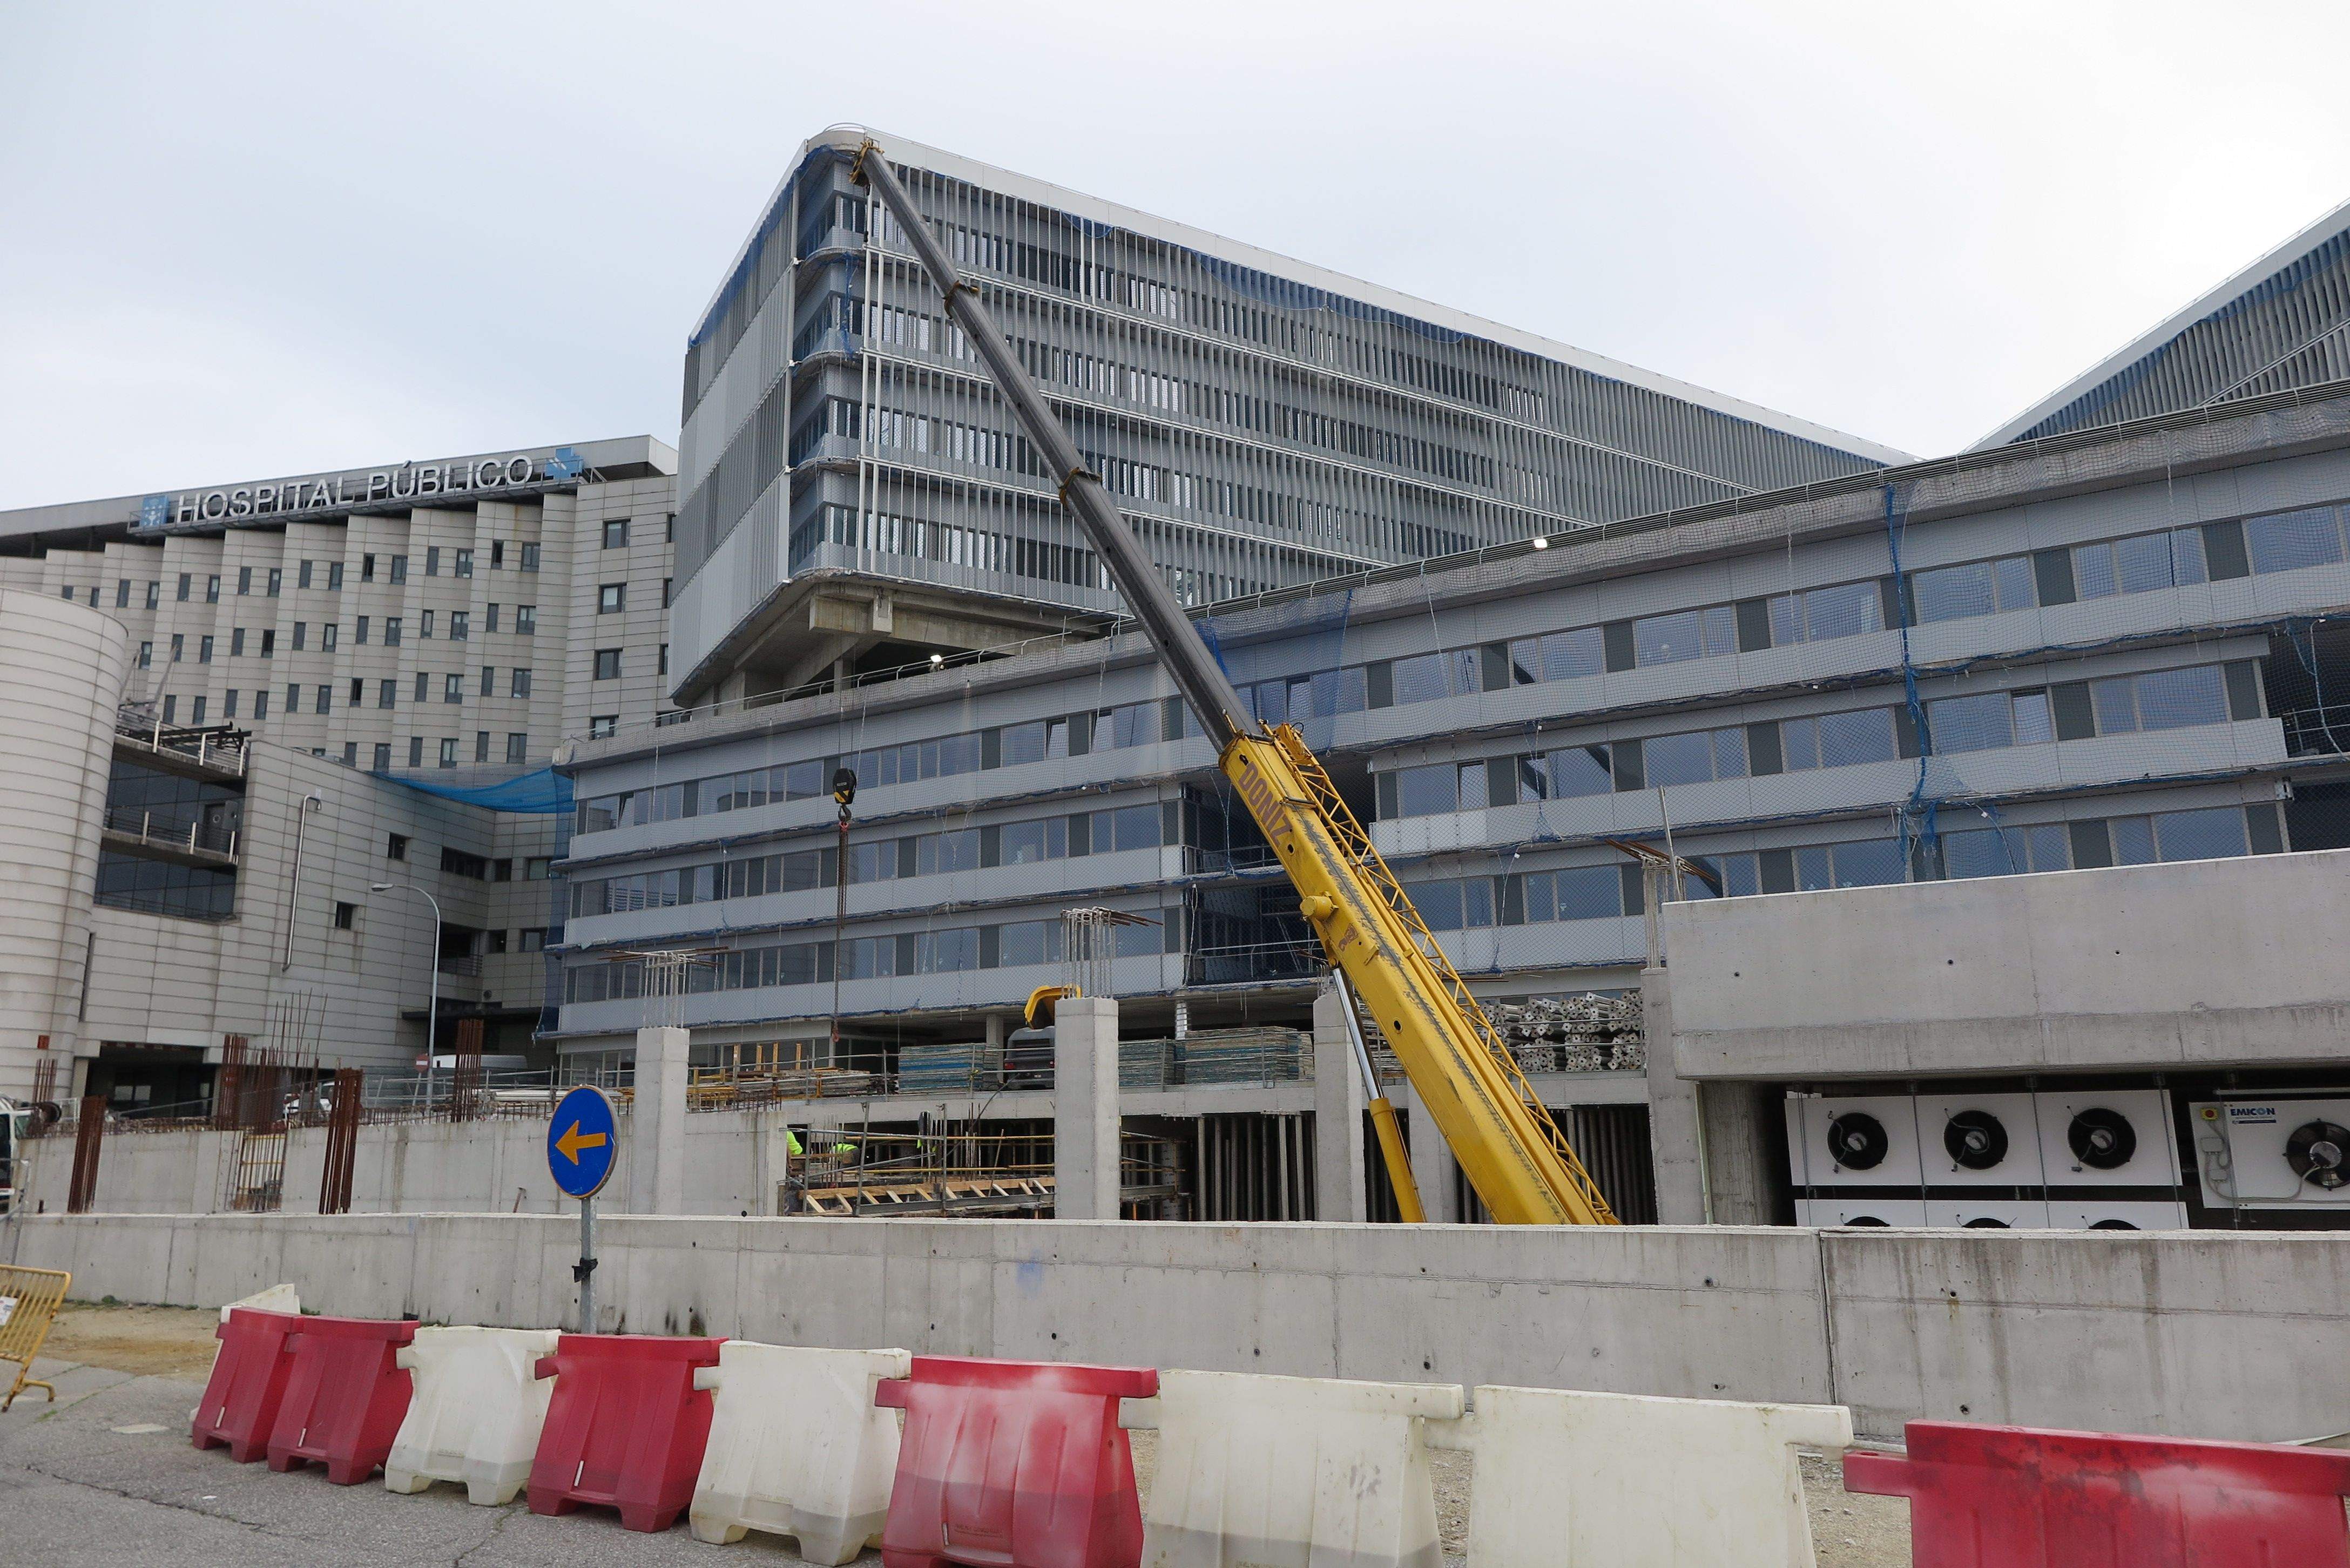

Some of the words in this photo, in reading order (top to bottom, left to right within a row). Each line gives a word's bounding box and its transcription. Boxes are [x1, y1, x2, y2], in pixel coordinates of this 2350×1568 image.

[177, 476, 354, 523] HOSPITAL
[366, 455, 534, 501] PÚBLICO
[1239, 761, 1293, 847] DONIZ
[2230, 1107, 2276, 1116] EMICON
